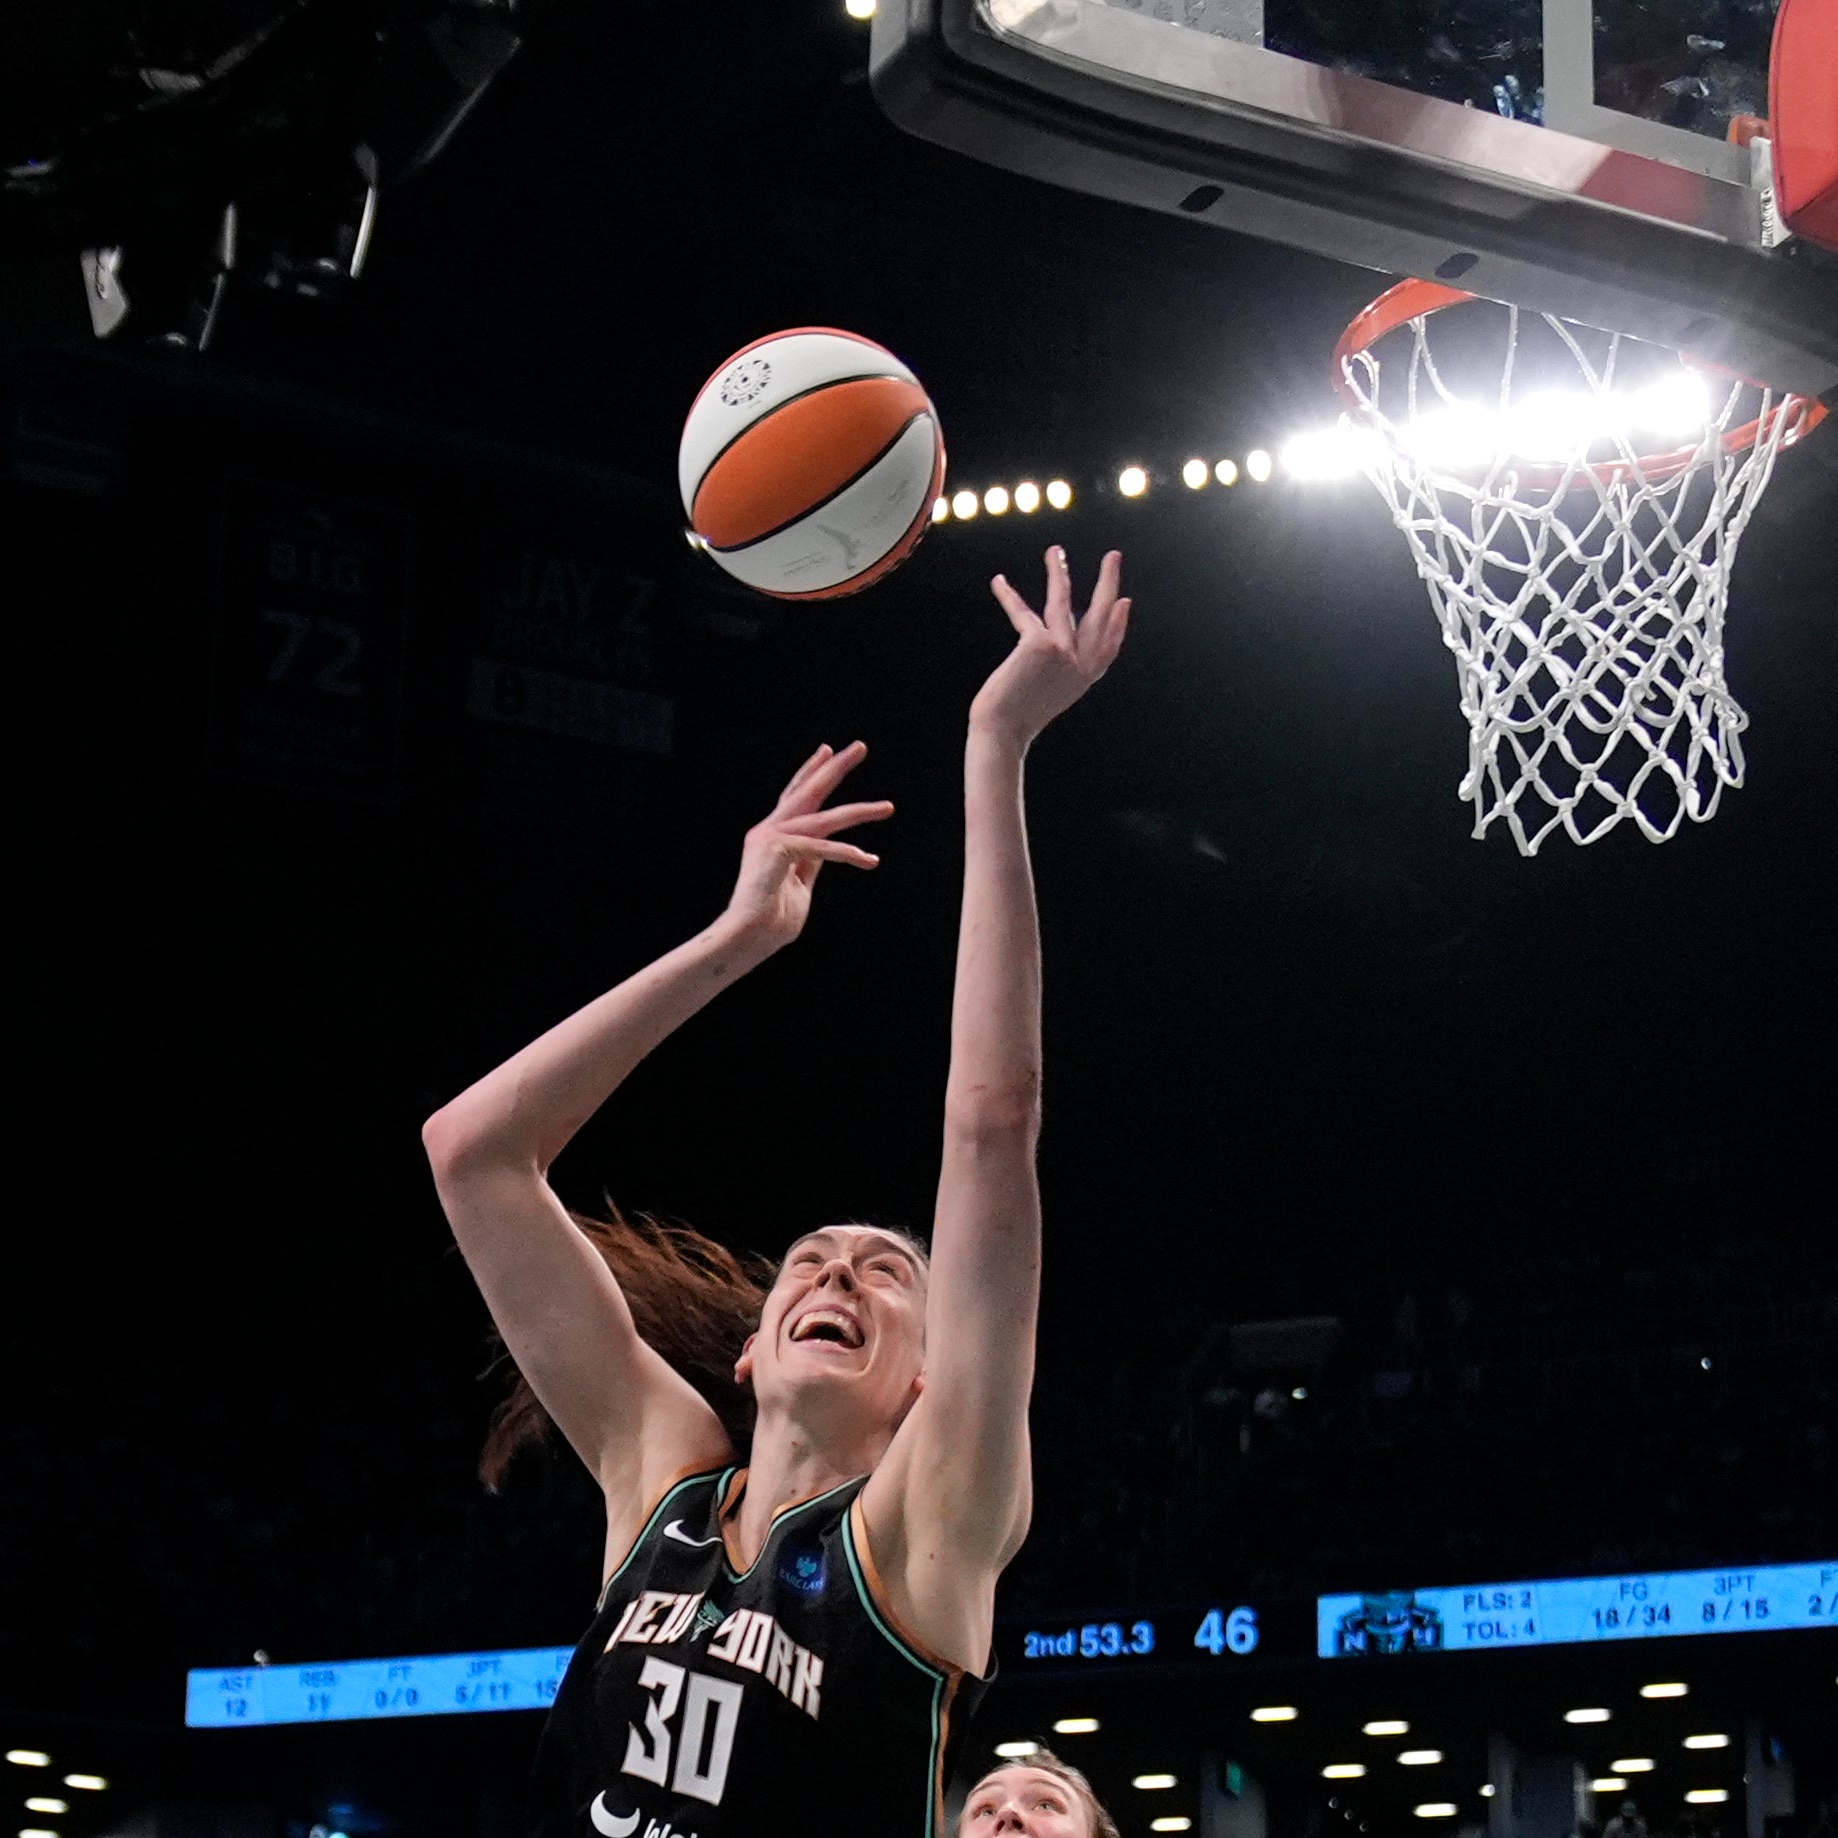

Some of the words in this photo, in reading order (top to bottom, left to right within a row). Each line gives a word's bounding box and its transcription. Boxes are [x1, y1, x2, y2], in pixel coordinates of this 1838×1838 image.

[1620, 1582, 1649, 1601] FG
[1024, 1629, 1078, 1658] 2nd
[1079, 1620, 1156, 1658] 53.3
[1193, 1605, 1260, 1655] 46
[1462, 1621, 1517, 1640] TOL:
[1523, 1617, 1536, 1637] 4
[219, 1675, 253, 1692] AST
[707, 1608, 824, 1721] YORK
[621, 1655, 745, 1806] 30
